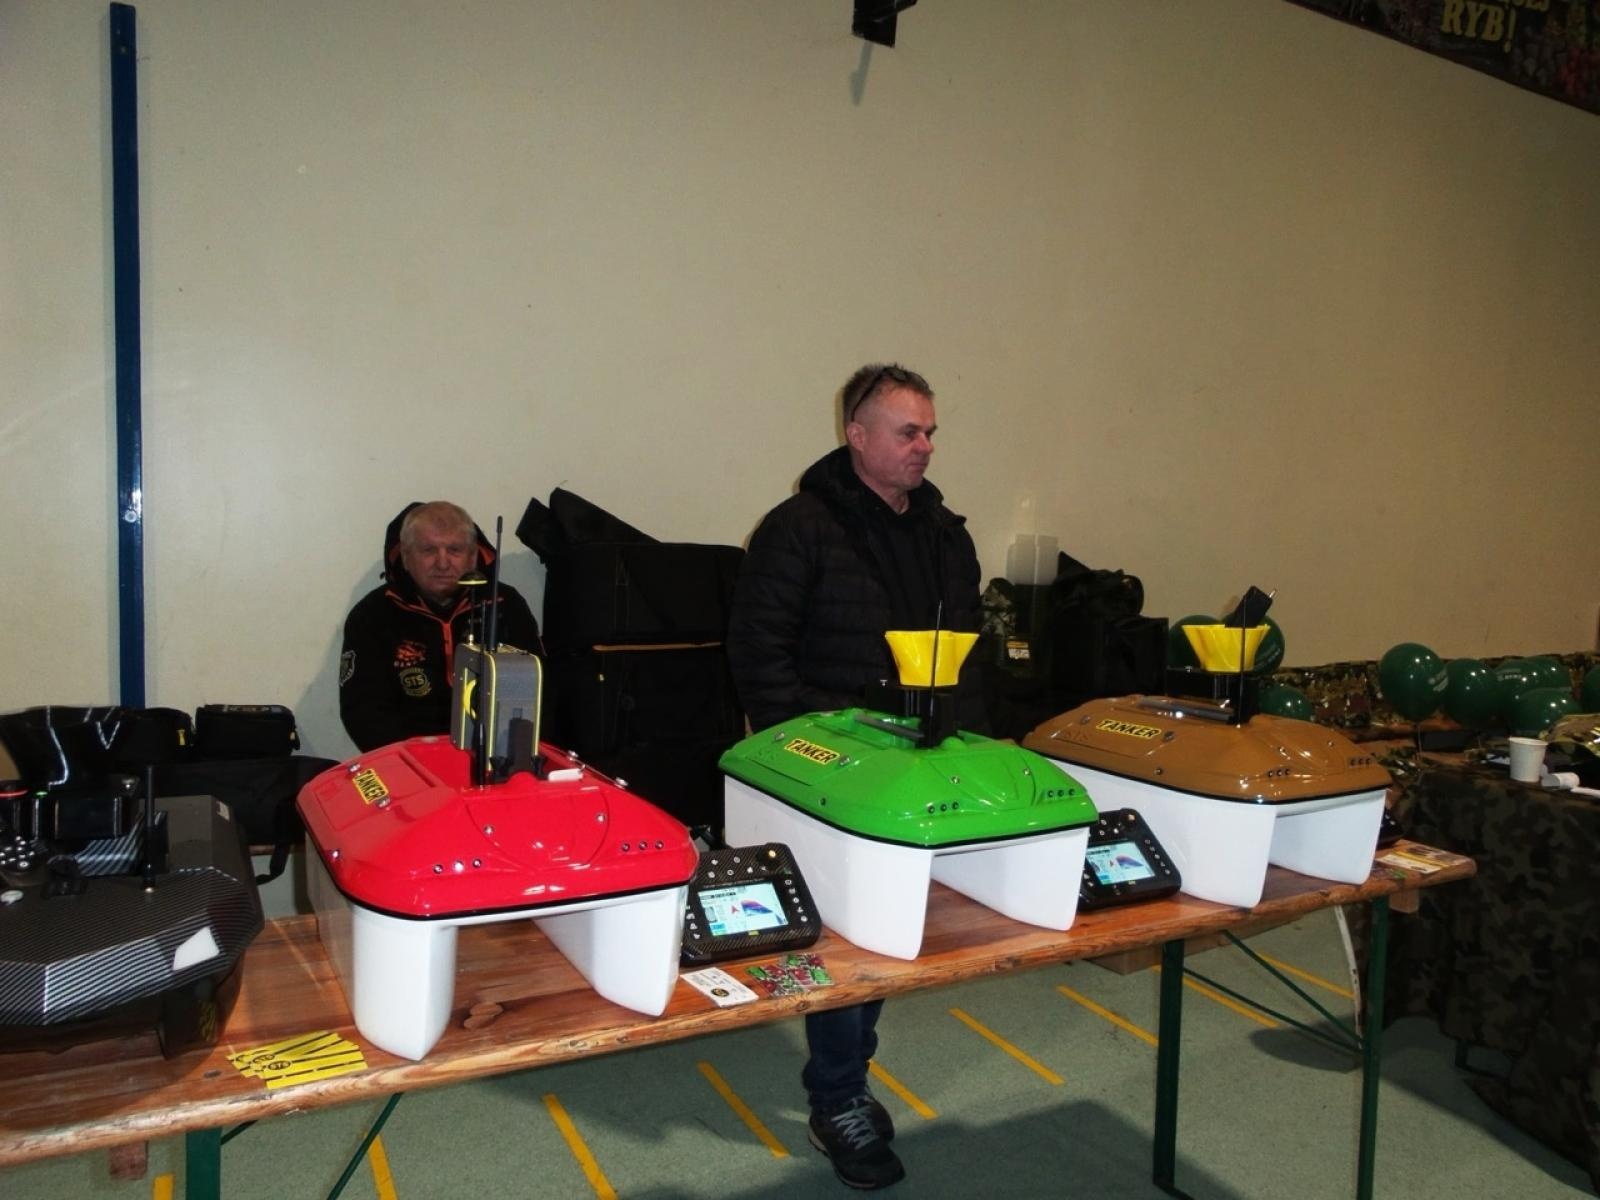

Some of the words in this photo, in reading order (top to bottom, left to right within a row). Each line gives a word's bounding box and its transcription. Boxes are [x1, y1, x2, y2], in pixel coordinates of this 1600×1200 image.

[1440, 0, 1516, 53] RYB!
[1097, 719, 1160, 739] TANKER
[786, 739, 837, 763] TANKER
[354, 768, 387, 802] TANKER
